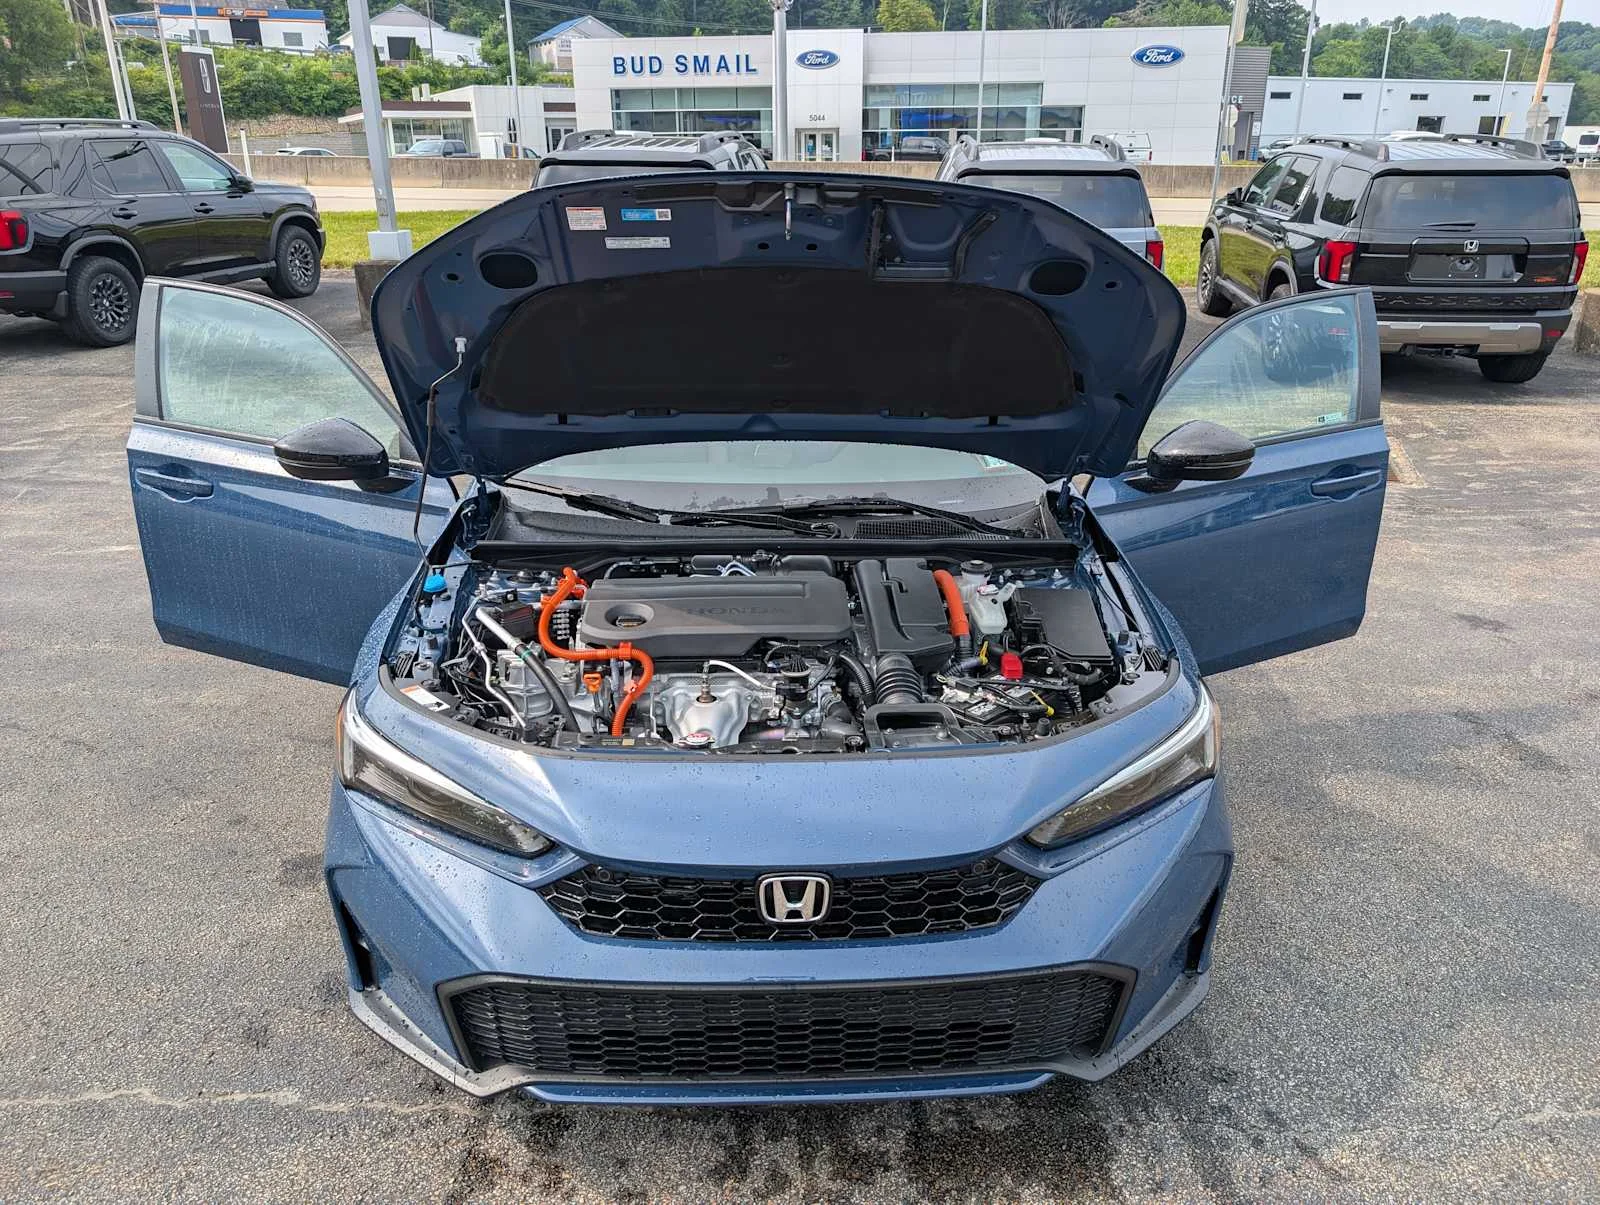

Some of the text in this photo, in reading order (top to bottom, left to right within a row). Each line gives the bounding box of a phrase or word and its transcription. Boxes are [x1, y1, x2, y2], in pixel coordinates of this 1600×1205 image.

[804, 52, 830, 65] Ford
[1142, 48, 1175, 63] Ford
[612, 54, 757, 75] BUD SMAIL
[809, 114, 826, 122] 5044
